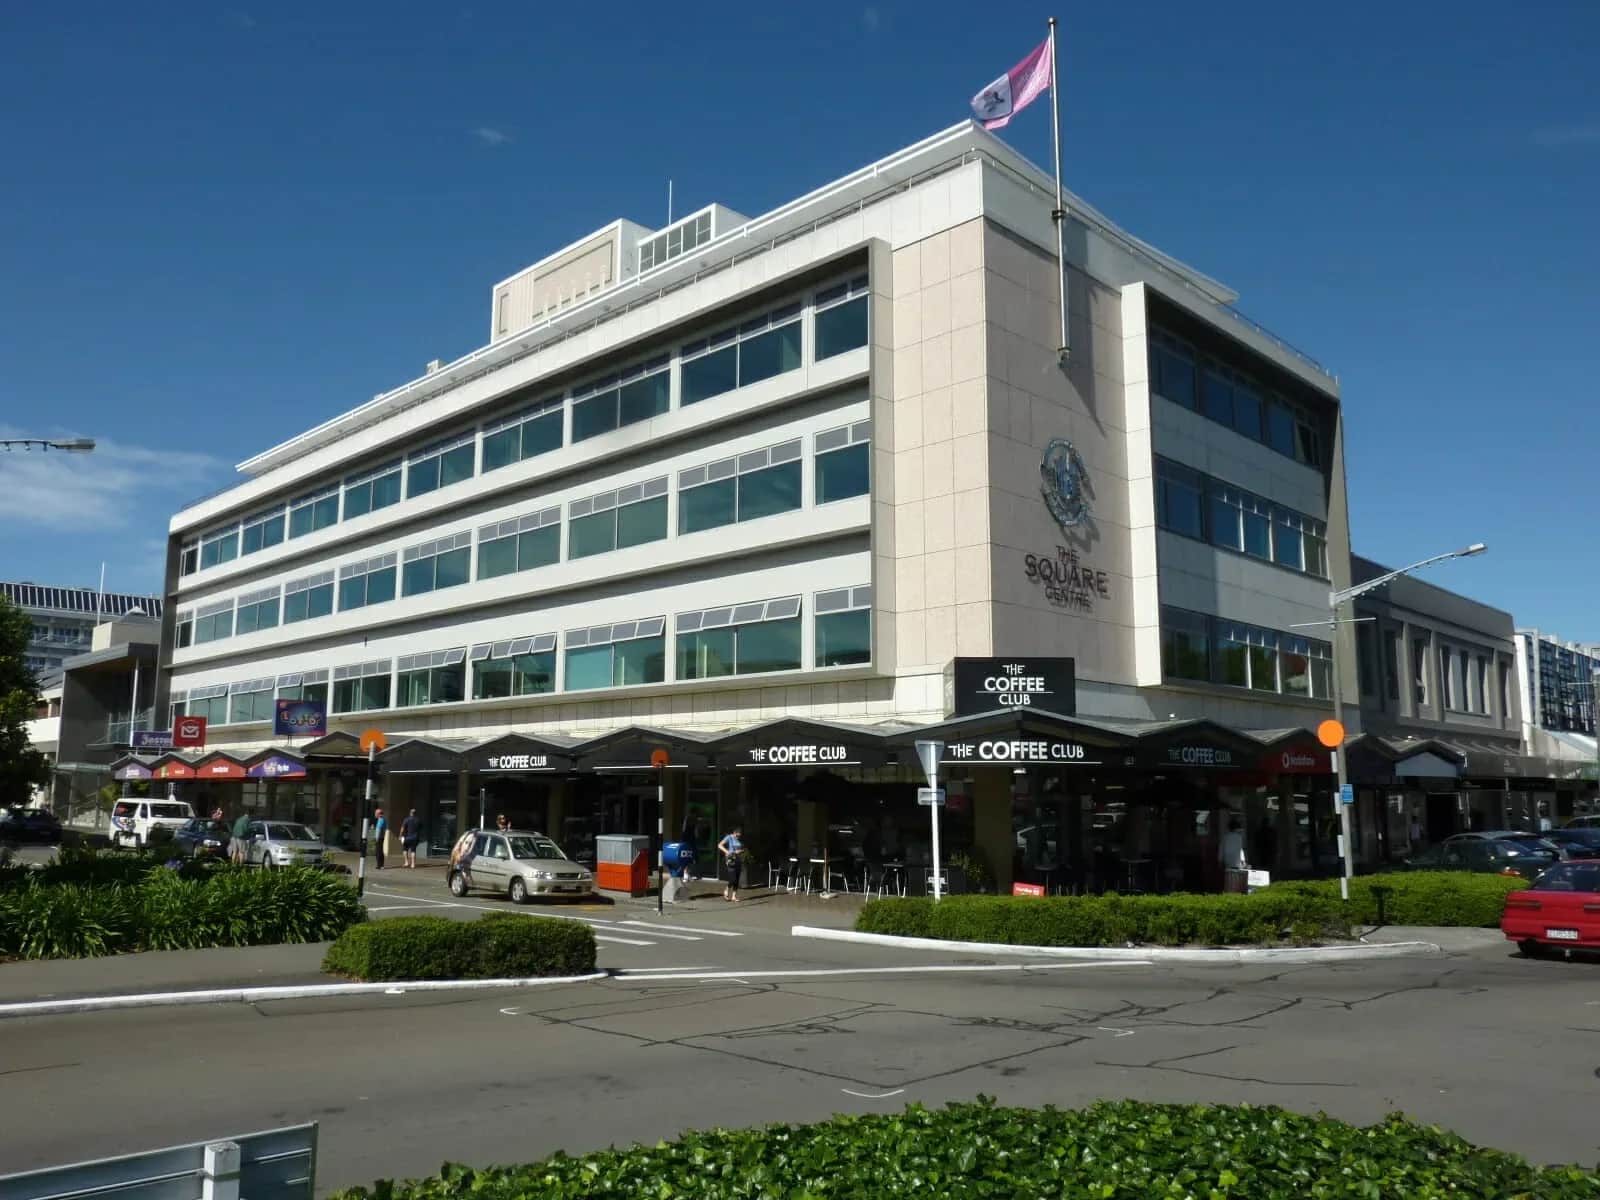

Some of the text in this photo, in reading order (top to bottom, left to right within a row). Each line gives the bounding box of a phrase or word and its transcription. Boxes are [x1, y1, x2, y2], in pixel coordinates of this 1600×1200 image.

[1056, 545, 1080, 566] THE
[1024, 554, 1109, 594] SQUARE
[1045, 585, 1091, 608] CENTRE
[1002, 663, 1026, 676] THE
[984, 677, 1045, 692] COFFEE
[998, 693, 1031, 705] CLUB
[749, 745, 847, 763] THE COFFEE CLUB
[947, 741, 1084, 760] THE COFFEE CLUB
[1167, 746, 1232, 763] THE COFFEE CLUB
[488, 755, 547, 769] THE COFFEE CLUB
